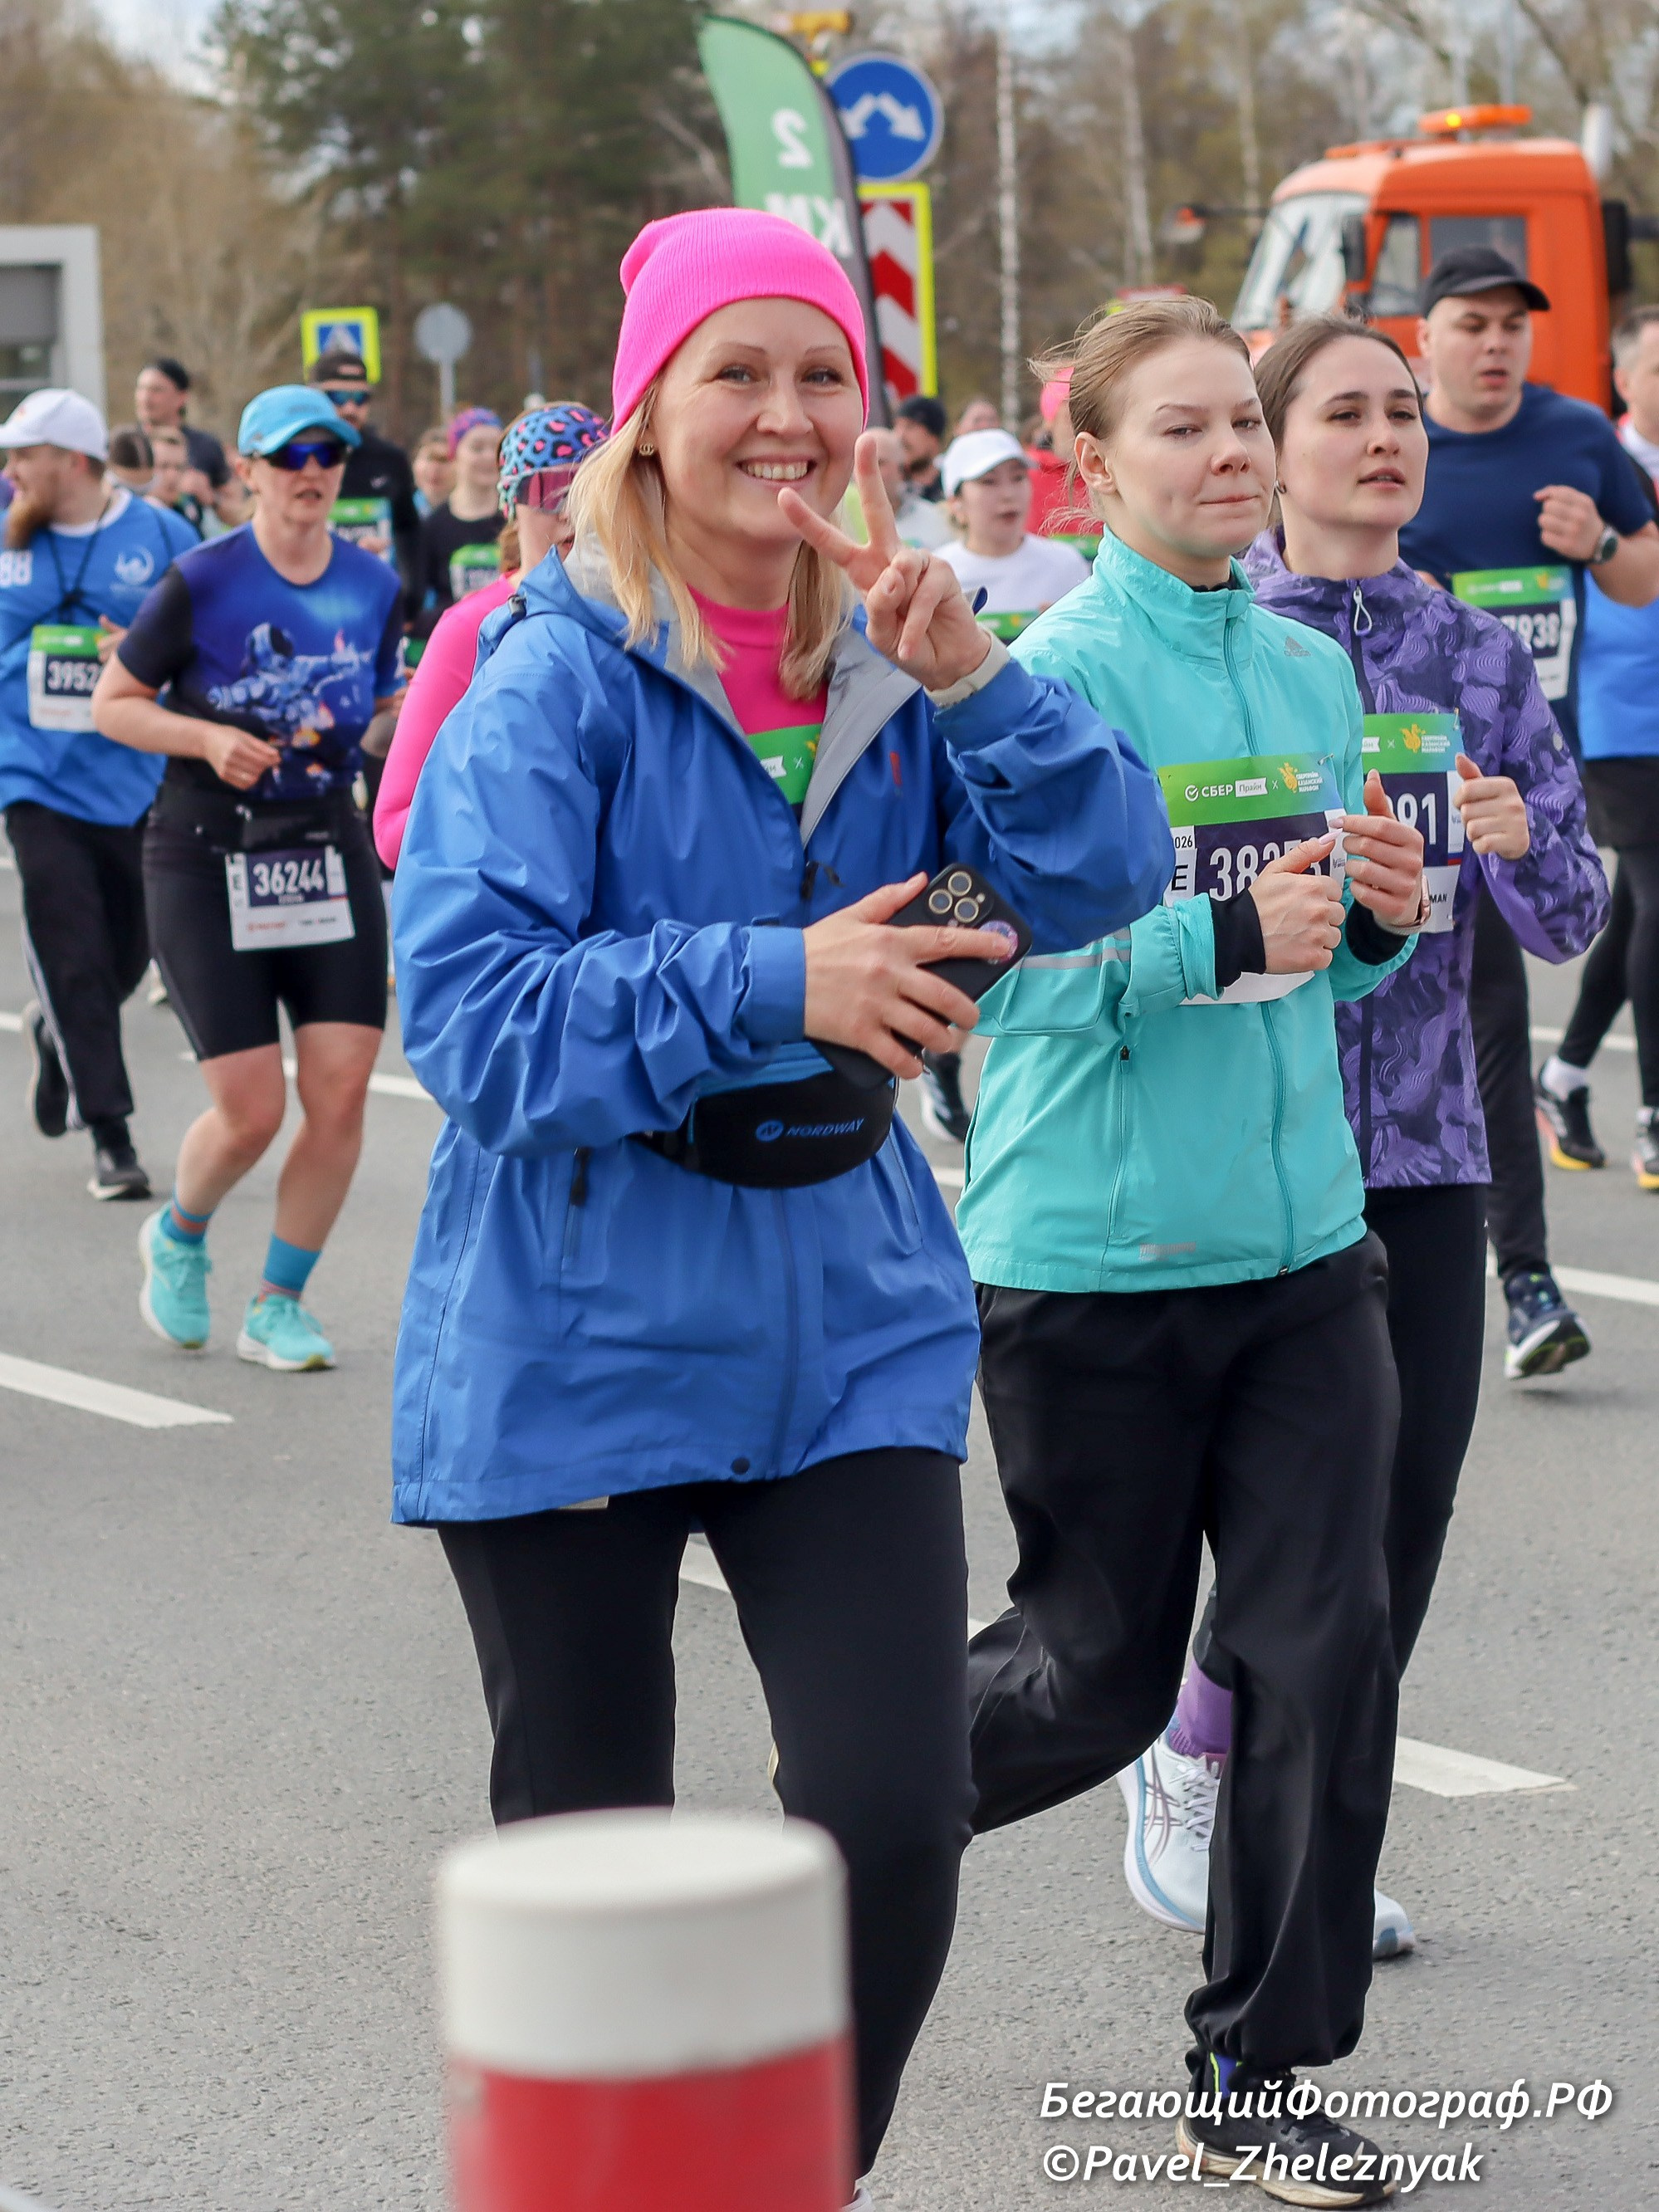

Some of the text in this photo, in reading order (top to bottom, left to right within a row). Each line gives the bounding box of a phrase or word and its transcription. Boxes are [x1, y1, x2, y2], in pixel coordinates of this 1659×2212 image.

[47, 661, 99, 691] 3952
[1201, 784, 1234, 798] СБЕР
[1385, 793, 1436, 845] 91
[1174, 835, 1192, 848] 026
[252, 858, 325, 896] 36244
[1429, 893, 1447, 903] MAN
[786, 1118, 864, 1136] NORDWAY
